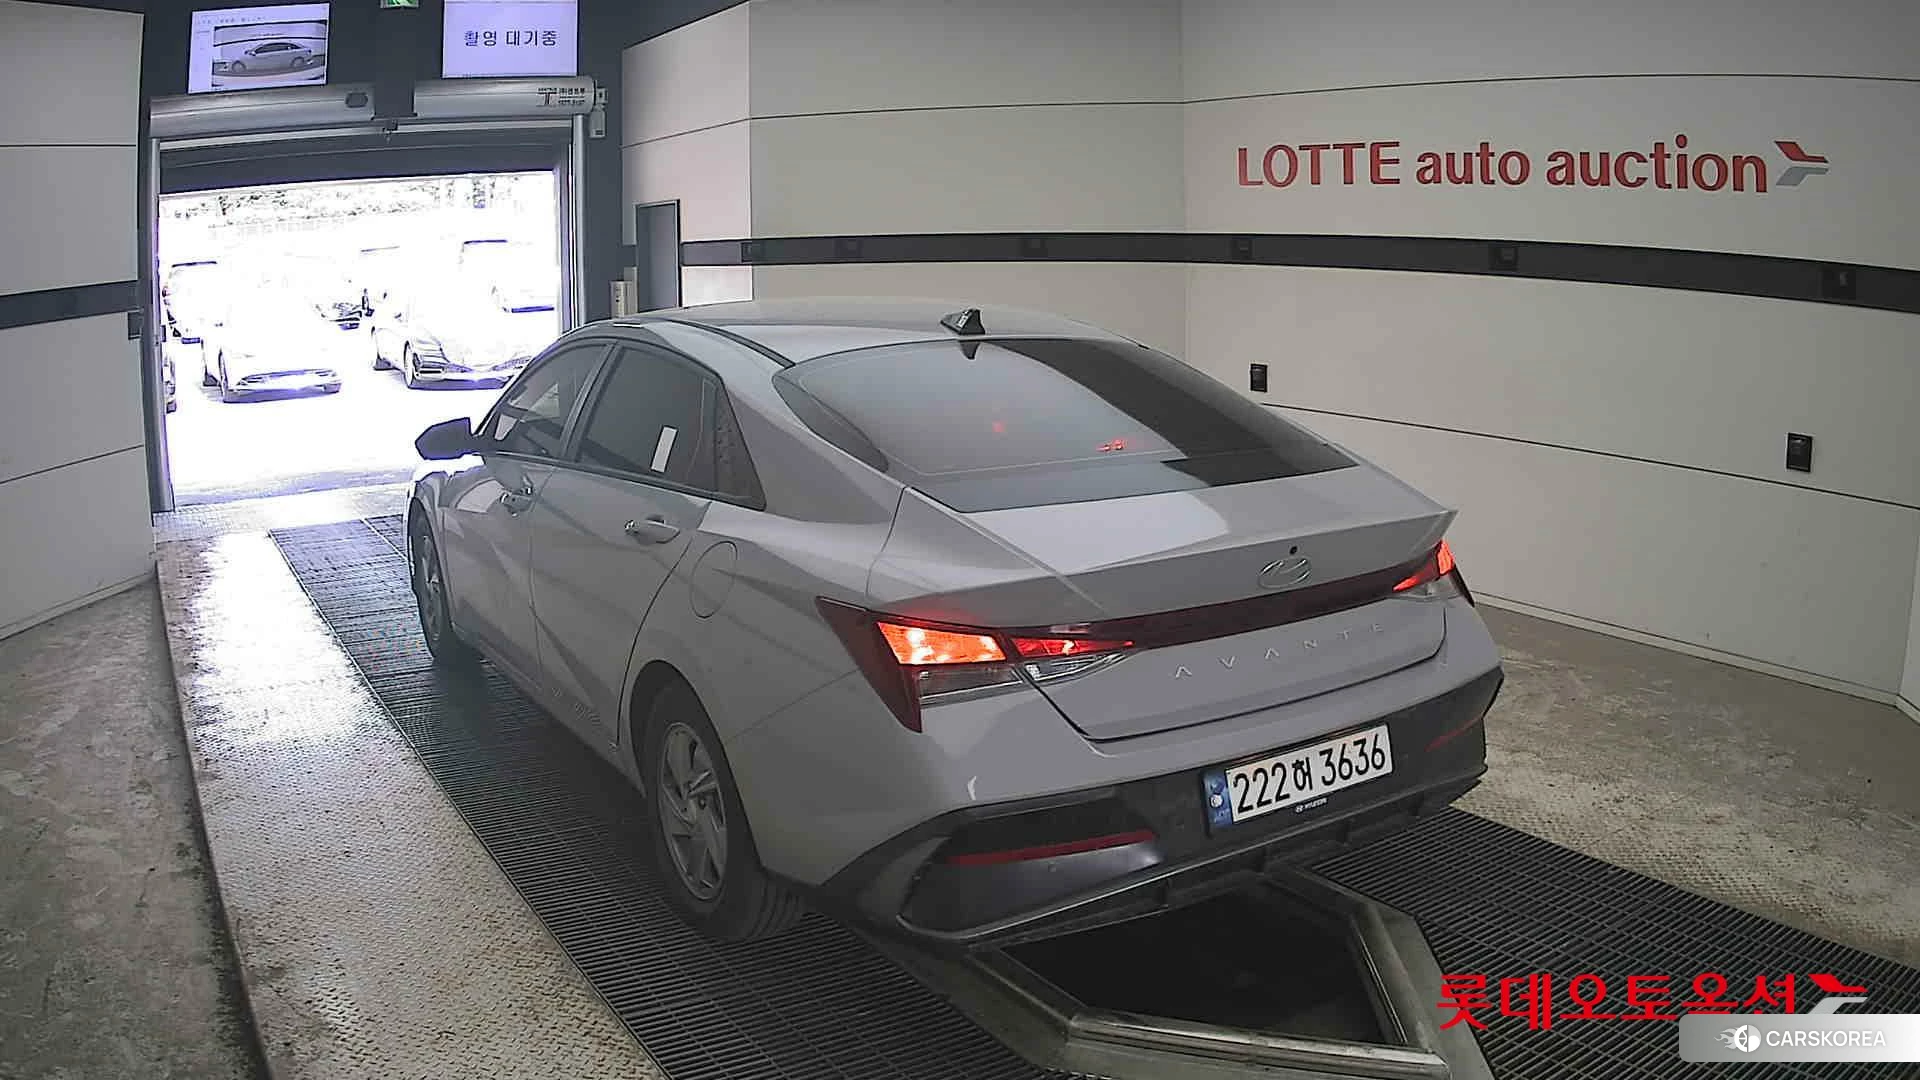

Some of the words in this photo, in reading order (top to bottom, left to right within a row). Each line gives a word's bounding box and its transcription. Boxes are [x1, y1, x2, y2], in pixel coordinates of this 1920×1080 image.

[464, 30, 497, 47] 촬영
[505, 30, 558, 47] 대기중
[1237, 140, 1401, 188] LOTTE
[1414, 141, 1531, 187] auto
[1545, 134, 1768, 194] auction
[1174, 622, 1385, 679] AVANTE
[1232, 756, 1314, 815] 222허
[1318, 733, 1387, 787] 3636
